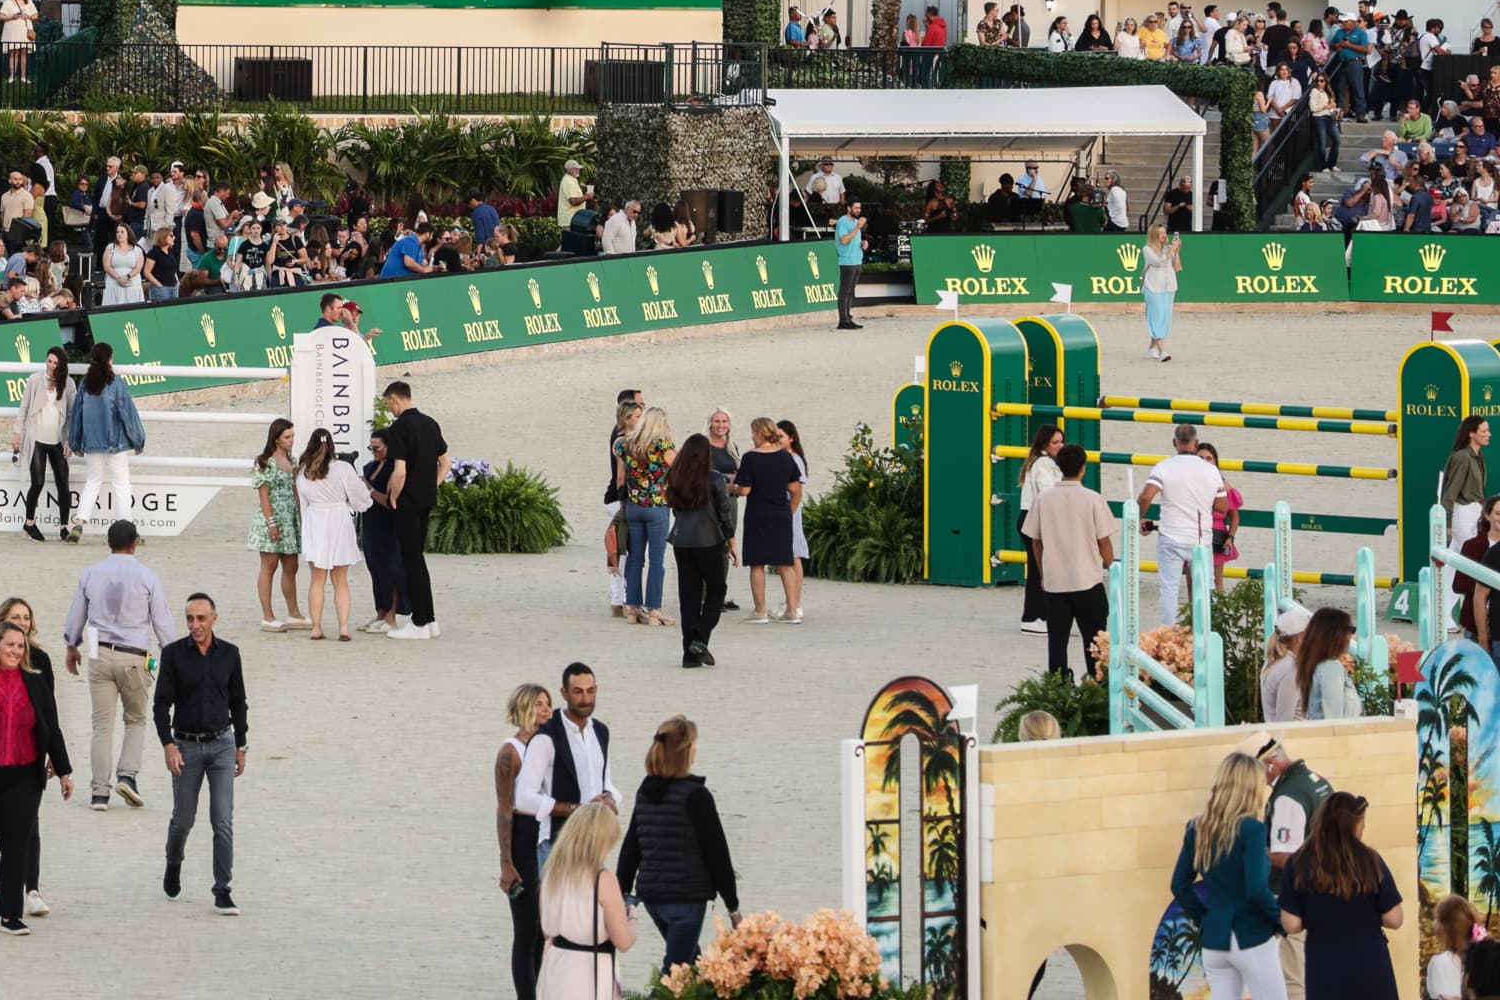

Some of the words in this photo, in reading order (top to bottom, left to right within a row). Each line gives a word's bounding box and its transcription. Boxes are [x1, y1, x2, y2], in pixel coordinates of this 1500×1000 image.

[804, 283, 838, 303] ROLEX
[946, 277, 1029, 295] ROLEX
[1091, 276, 1142, 295] ROL
[1236, 276, 1318, 293] ROLEX
[1384, 276, 1478, 296] ROLEX
[698, 293, 733, 315] ROLEX
[752, 288, 786, 308] ROLEX
[583, 306, 621, 328] ROLEX
[643, 299, 678, 321] ROLEX
[464, 319, 503, 342] ROLEX
[524, 312, 562, 335] ROLEX
[401, 327, 441, 350] ROLEX
[195, 352, 238, 369] ROLEX
[265, 345, 294, 368] ROL
[332, 338, 350, 445] BAINBRI
[932, 379, 980, 393] ROLEX
[1406, 403, 1457, 417] ROLEX
[1472, 404, 1500, 417] ROLE
[1394, 589, 1409, 615] 4
